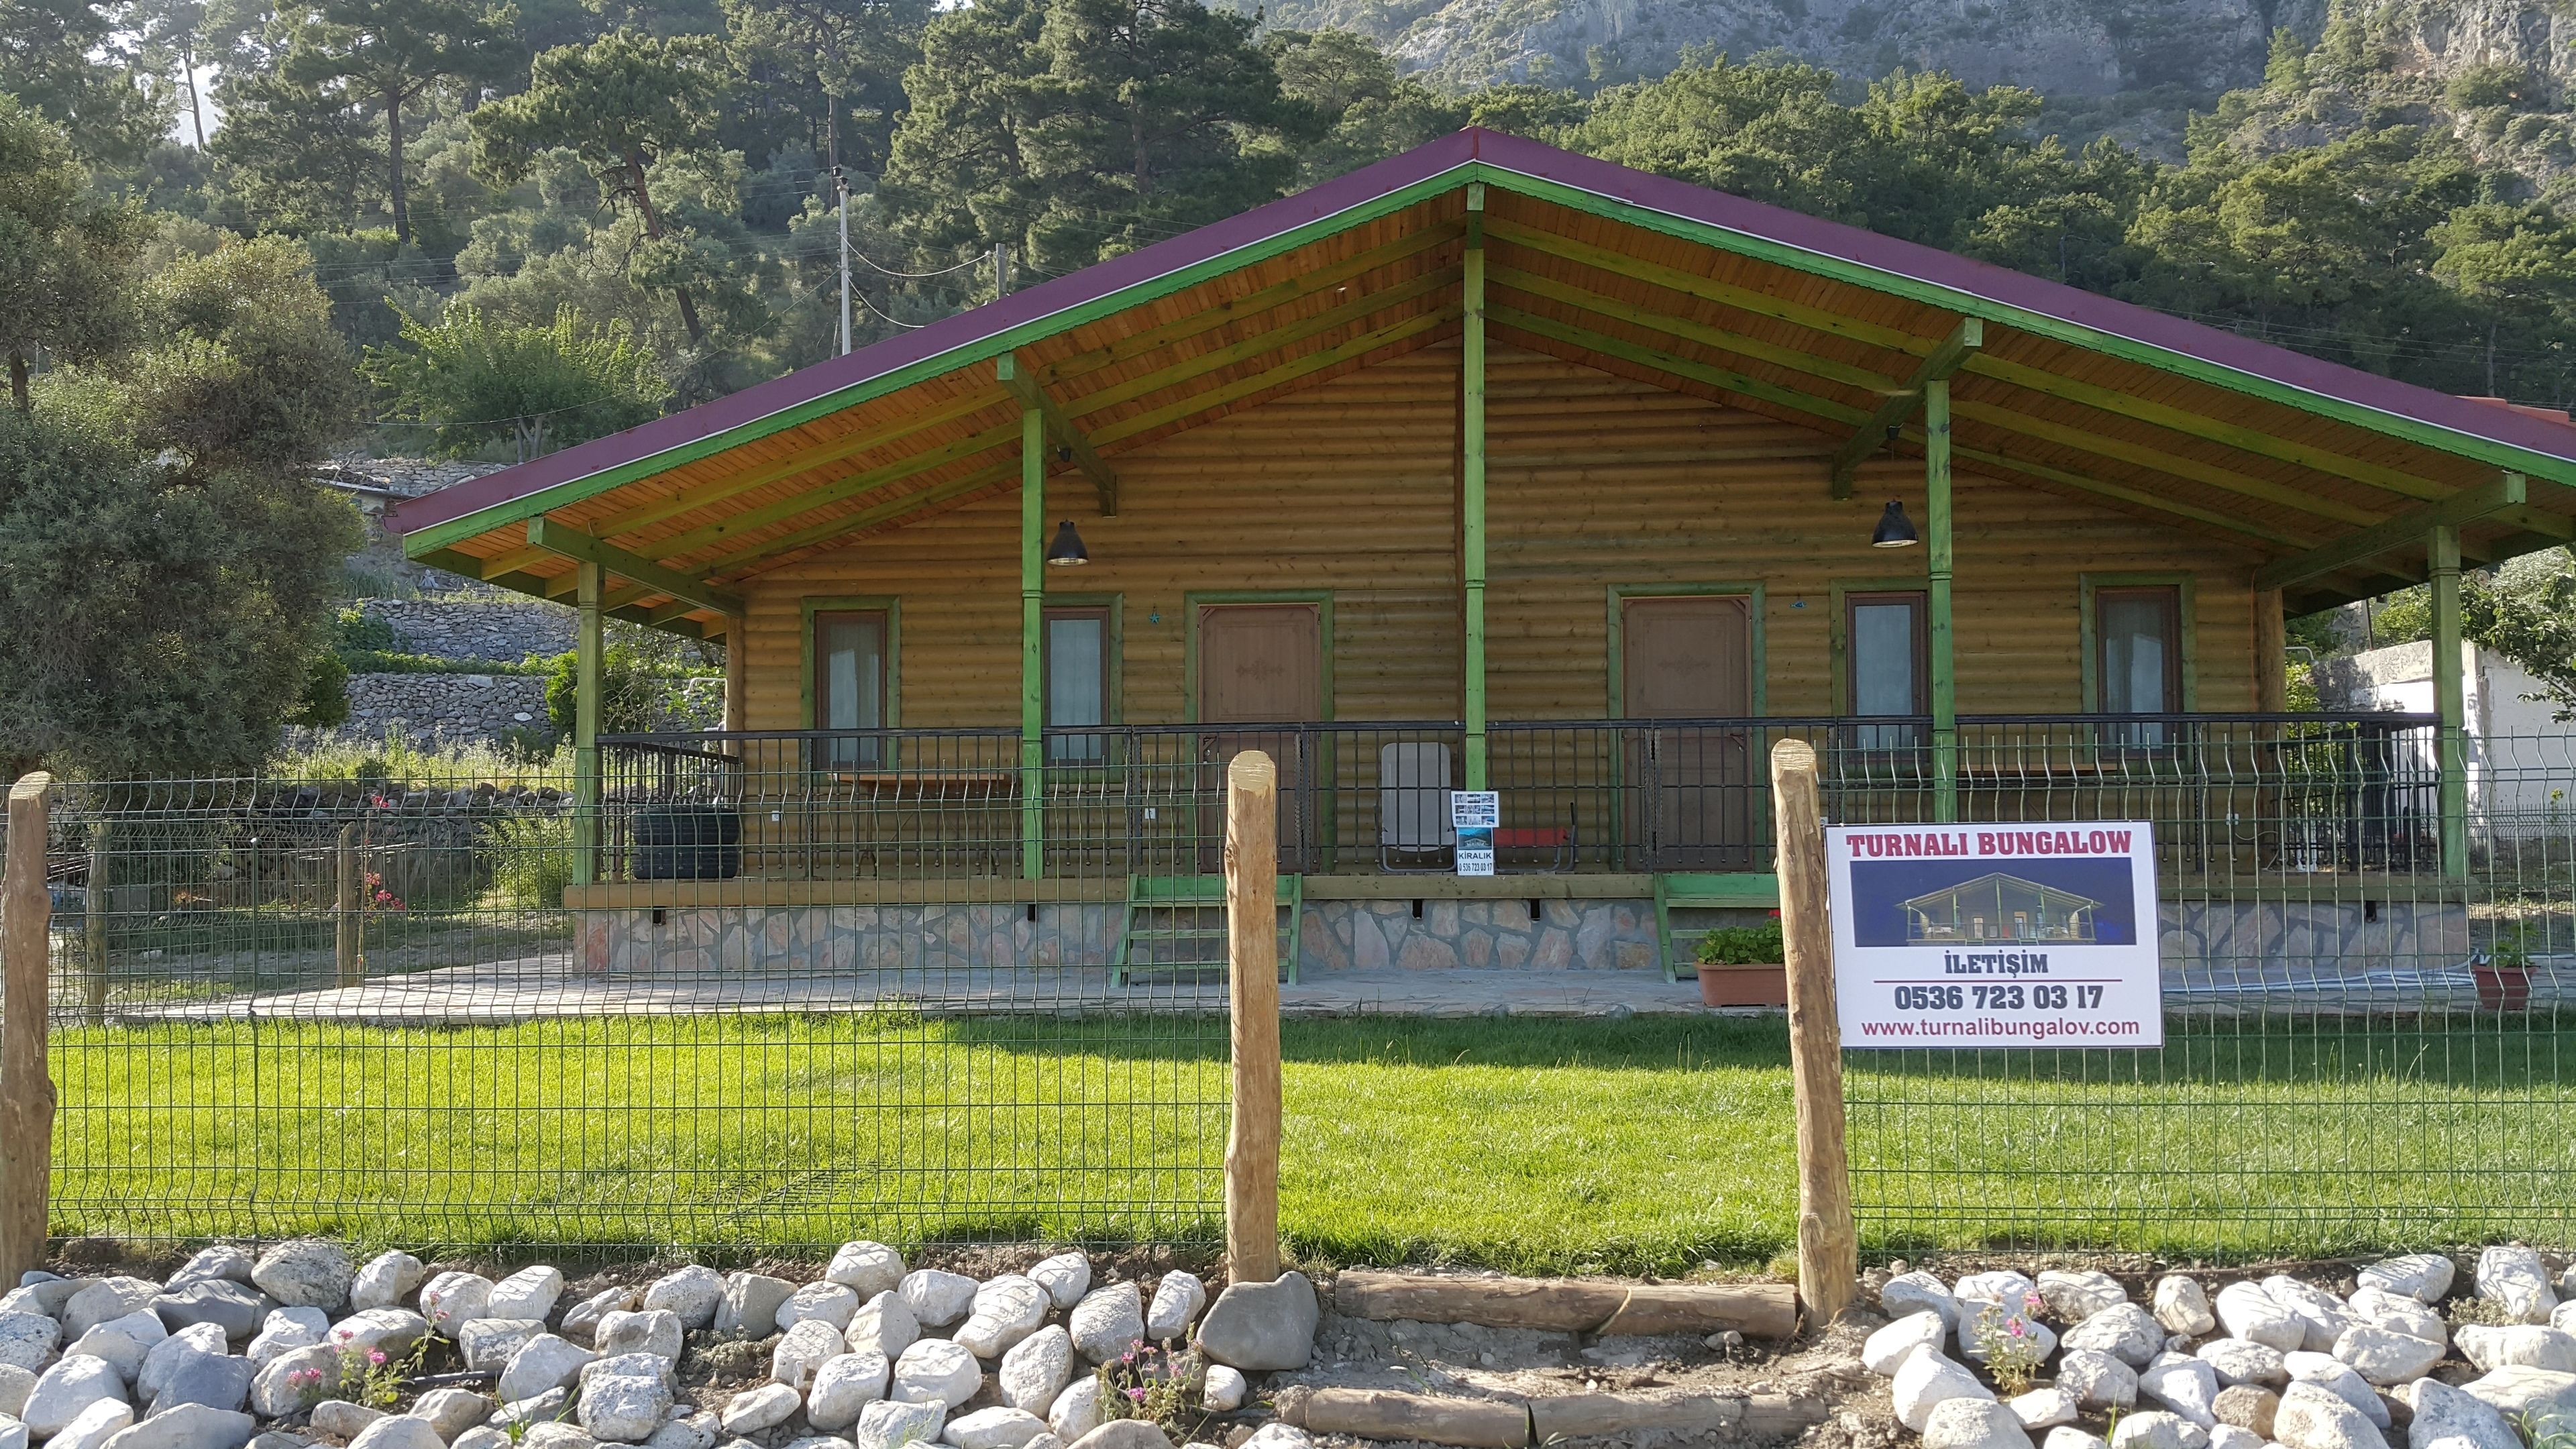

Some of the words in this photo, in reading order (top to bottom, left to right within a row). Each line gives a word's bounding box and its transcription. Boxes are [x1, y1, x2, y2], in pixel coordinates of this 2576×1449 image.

[1458, 851, 1491, 859] KİRALIK
[1846, 833, 1968, 857] TURNALI
[1978, 830, 2132, 856] BUNGALOW
[1481, 863, 1486, 871] 03
[1487, 863, 1492, 871] 17
[1945, 949, 2048, 978] İLETİŞİM
[1894, 985, 1964, 1010] 0536
[1972, 985, 2025, 1010] 723
[2033, 985, 2068, 1009] 03
[2077, 985, 2104, 1009] 17
[1862, 1018, 2140, 1039] www.turnalibungalov.com
